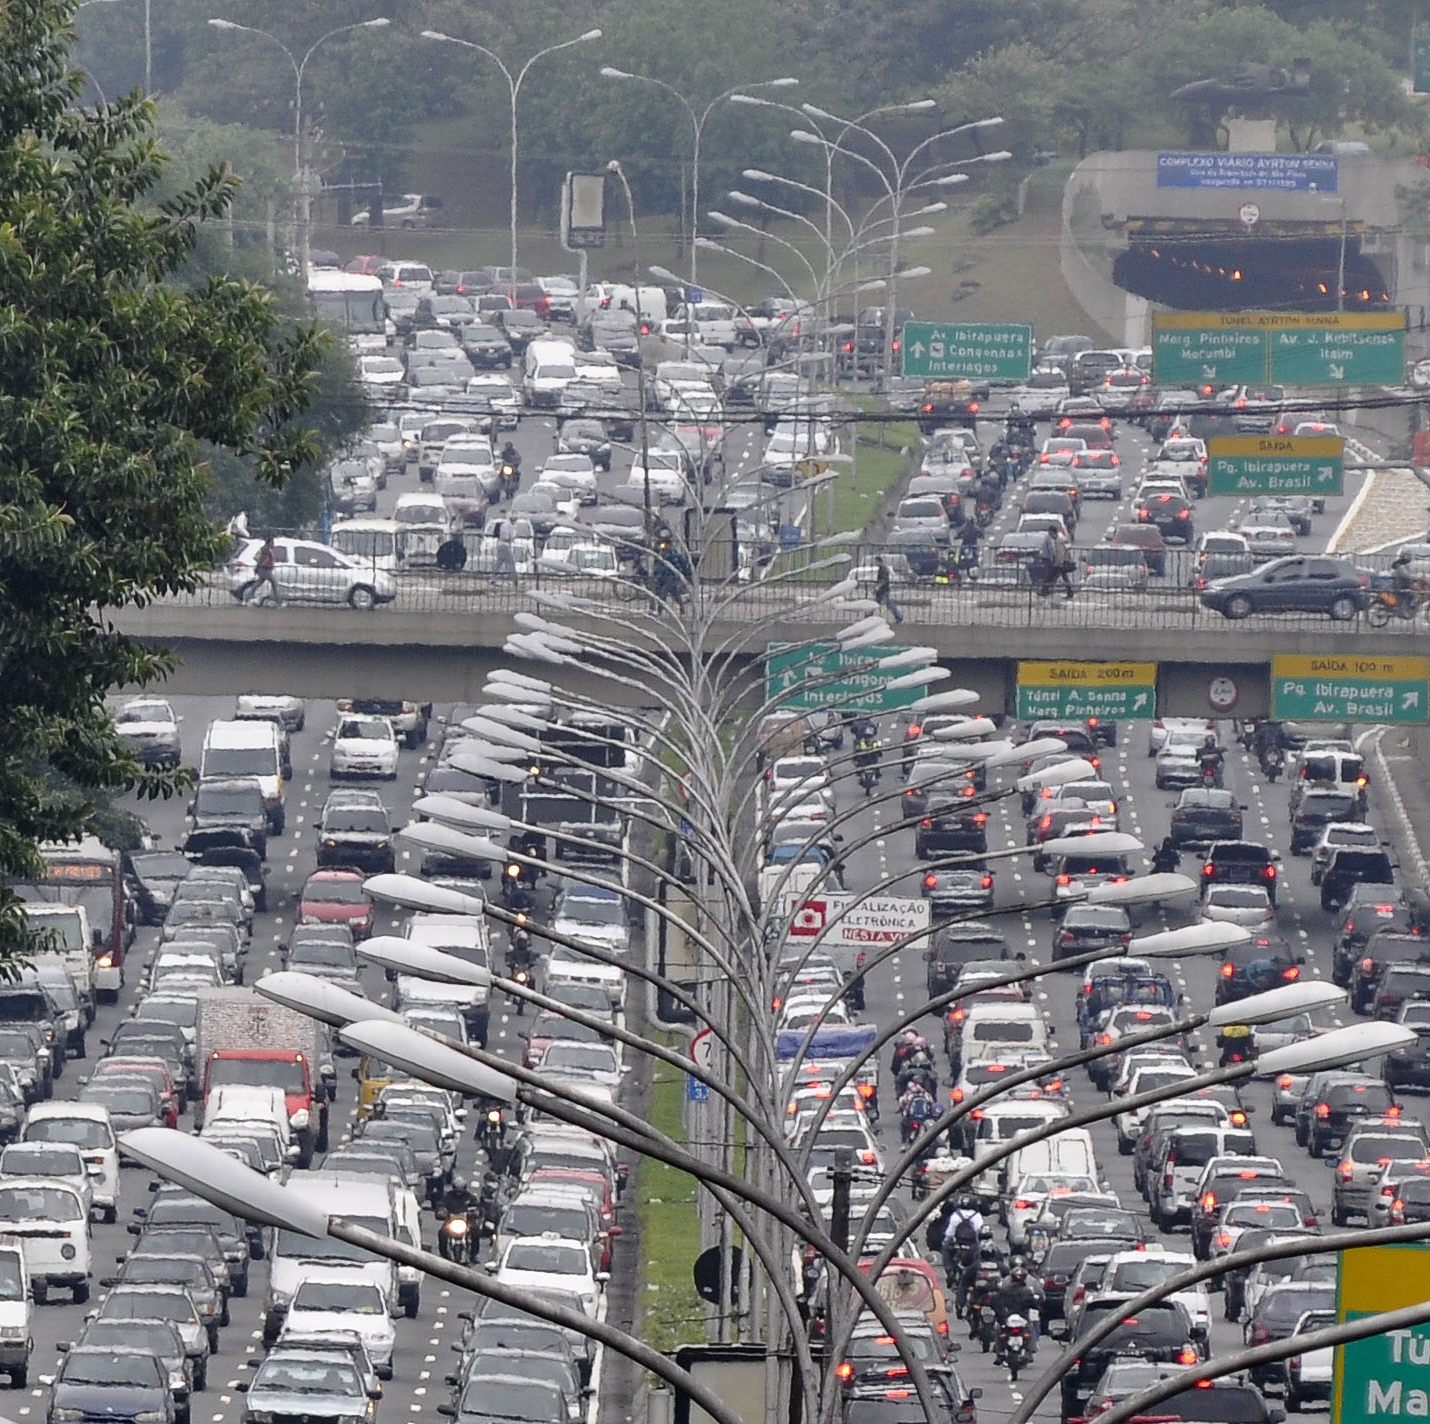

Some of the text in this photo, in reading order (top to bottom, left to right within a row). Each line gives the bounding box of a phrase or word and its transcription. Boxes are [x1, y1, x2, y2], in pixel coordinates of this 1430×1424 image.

[955, 331, 1024, 343] Ibirapuera
[929, 360, 998, 374] Interlagos
[1237, 476, 1311, 489] Av. Brasil
[1315, 683, 1394, 699] Ibirapuera
[1314, 700, 1394, 716] Av. Brasil
[843, 928, 885, 942] NESTA
